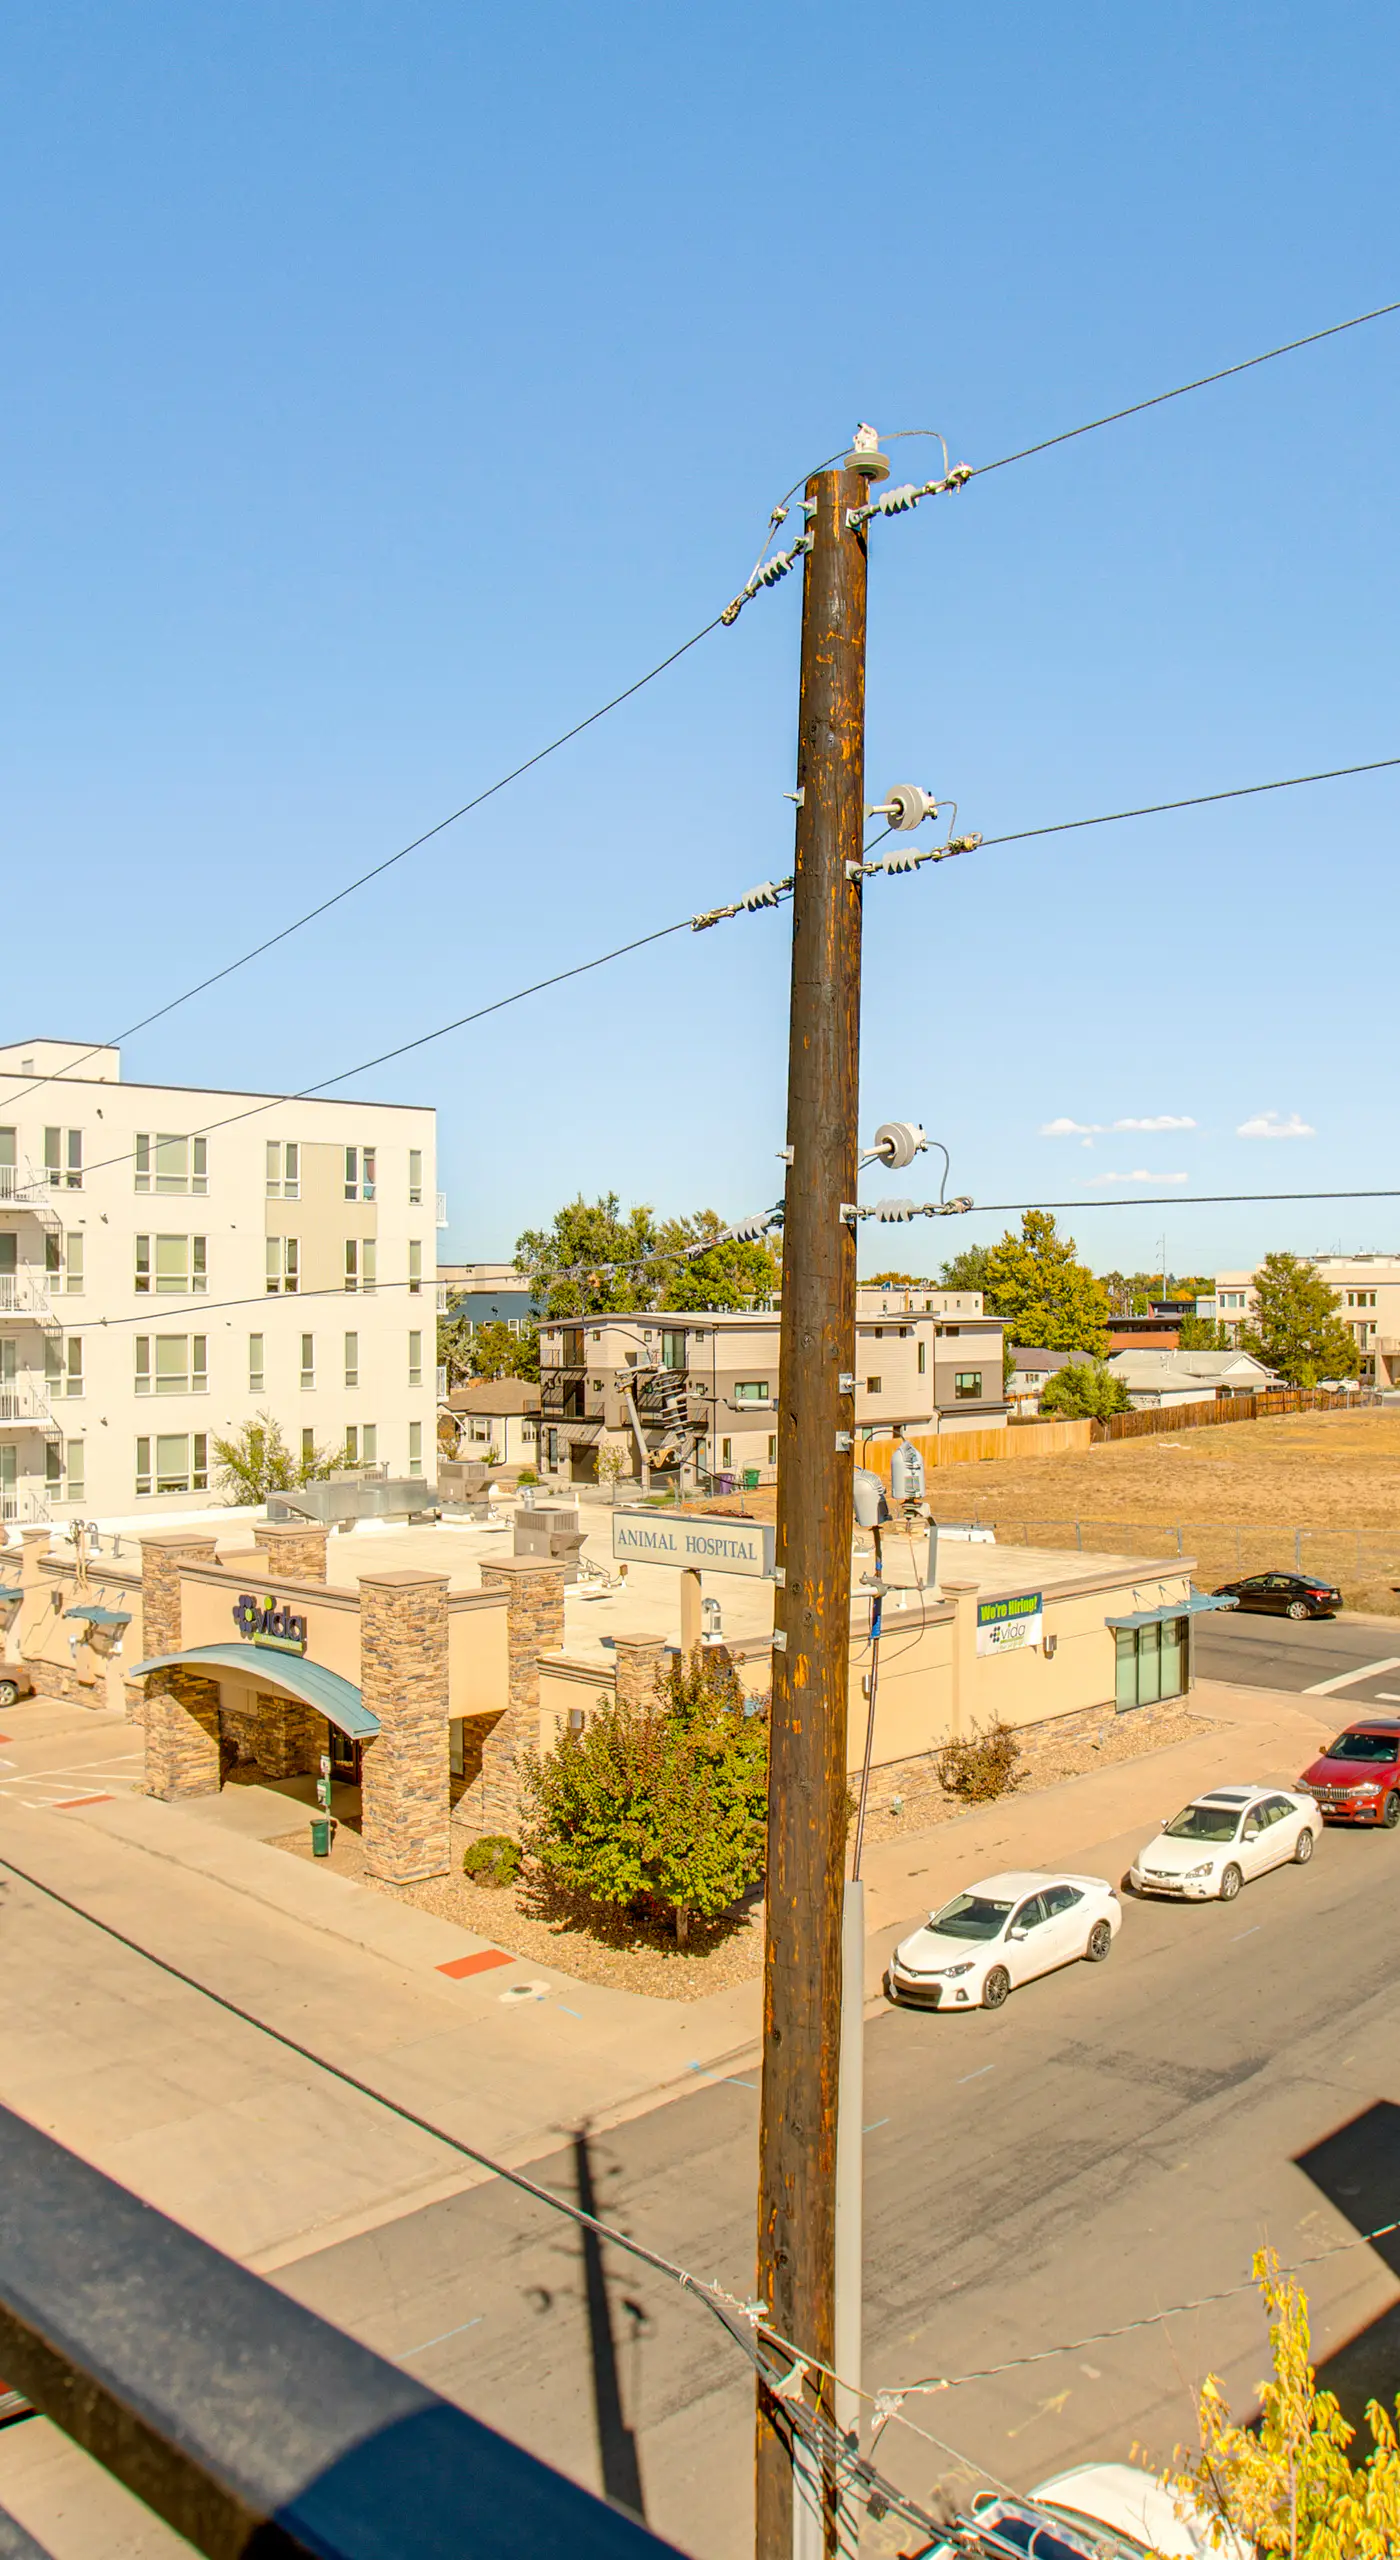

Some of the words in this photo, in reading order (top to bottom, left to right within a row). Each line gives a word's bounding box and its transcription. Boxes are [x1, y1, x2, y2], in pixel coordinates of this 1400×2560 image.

[617, 1528, 678, 1551] ANIMAL
[685, 1535, 758, 1560] HOSPITAL
[255, 1596, 304, 1642] vida
[981, 1603, 1007, 1622] We're
[1008, 1595, 1038, 1616] Hiring!
